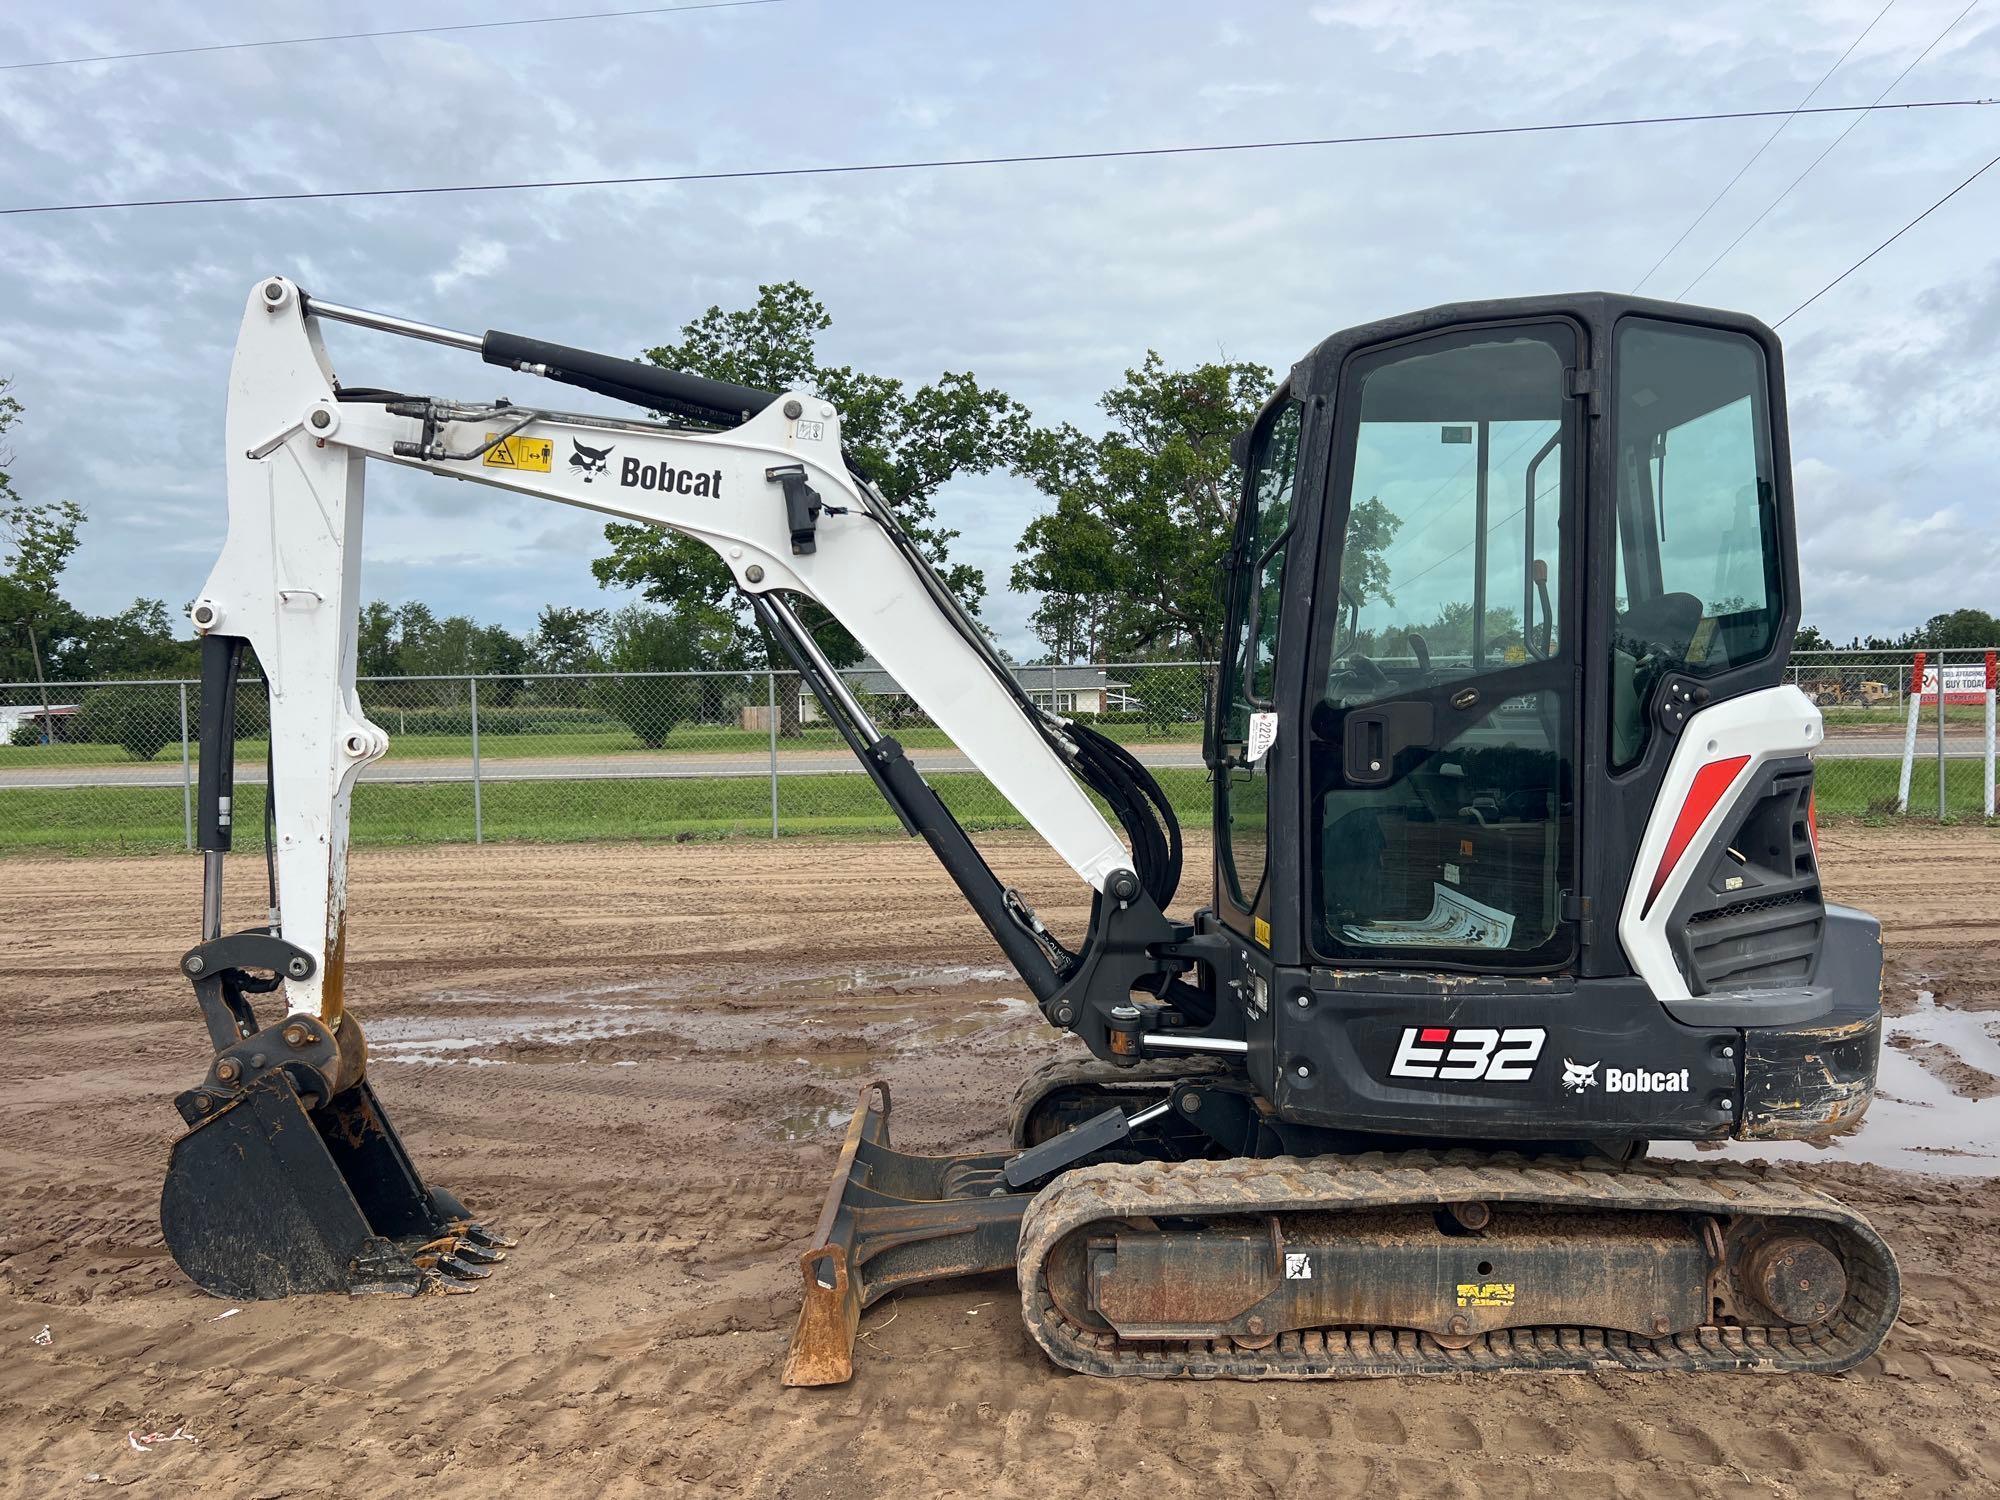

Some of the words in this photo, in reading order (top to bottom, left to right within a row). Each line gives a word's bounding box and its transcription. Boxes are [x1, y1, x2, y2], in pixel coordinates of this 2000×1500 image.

[621, 457, 722, 499] Bobcat
[1945, 680, 1960, 689] BUY
[1963, 679, 1985, 688] TODAY
[1390, 1028, 1546, 1080] E32
[1605, 1068, 1689, 1093] Bobcat
